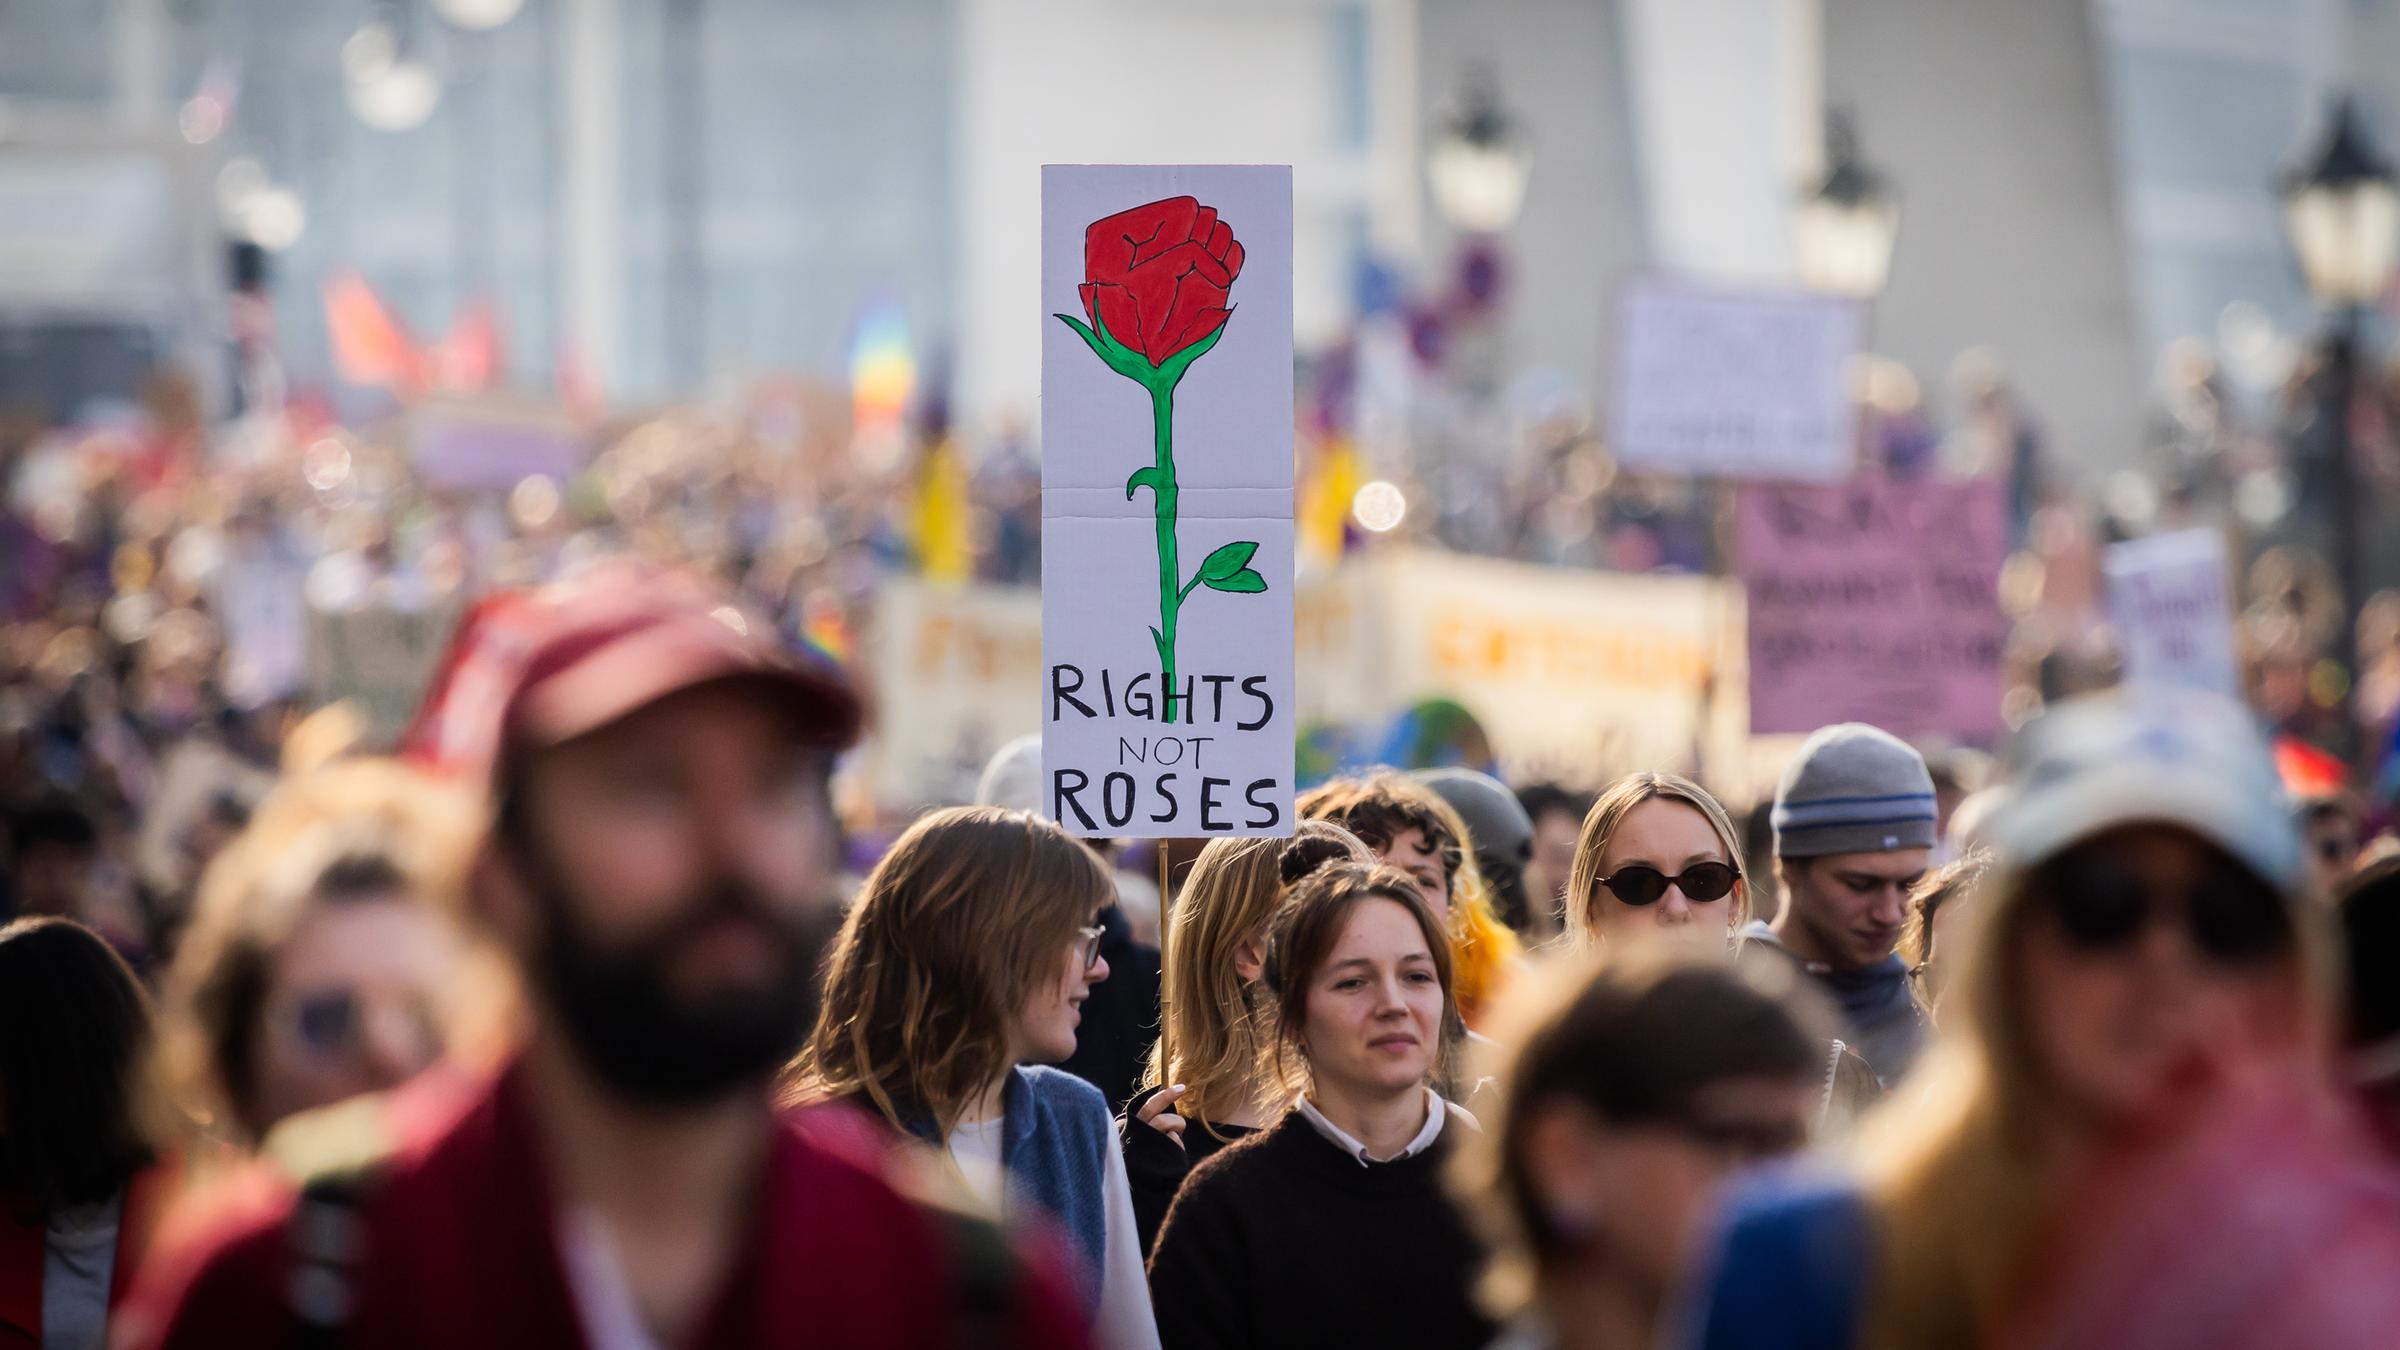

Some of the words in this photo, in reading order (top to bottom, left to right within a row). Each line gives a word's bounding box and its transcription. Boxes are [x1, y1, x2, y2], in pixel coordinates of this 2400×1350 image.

[1052, 664, 1273, 731] RIGHTS
[1120, 736, 1214, 769] NOT
[1054, 768, 1280, 831] ROSES
